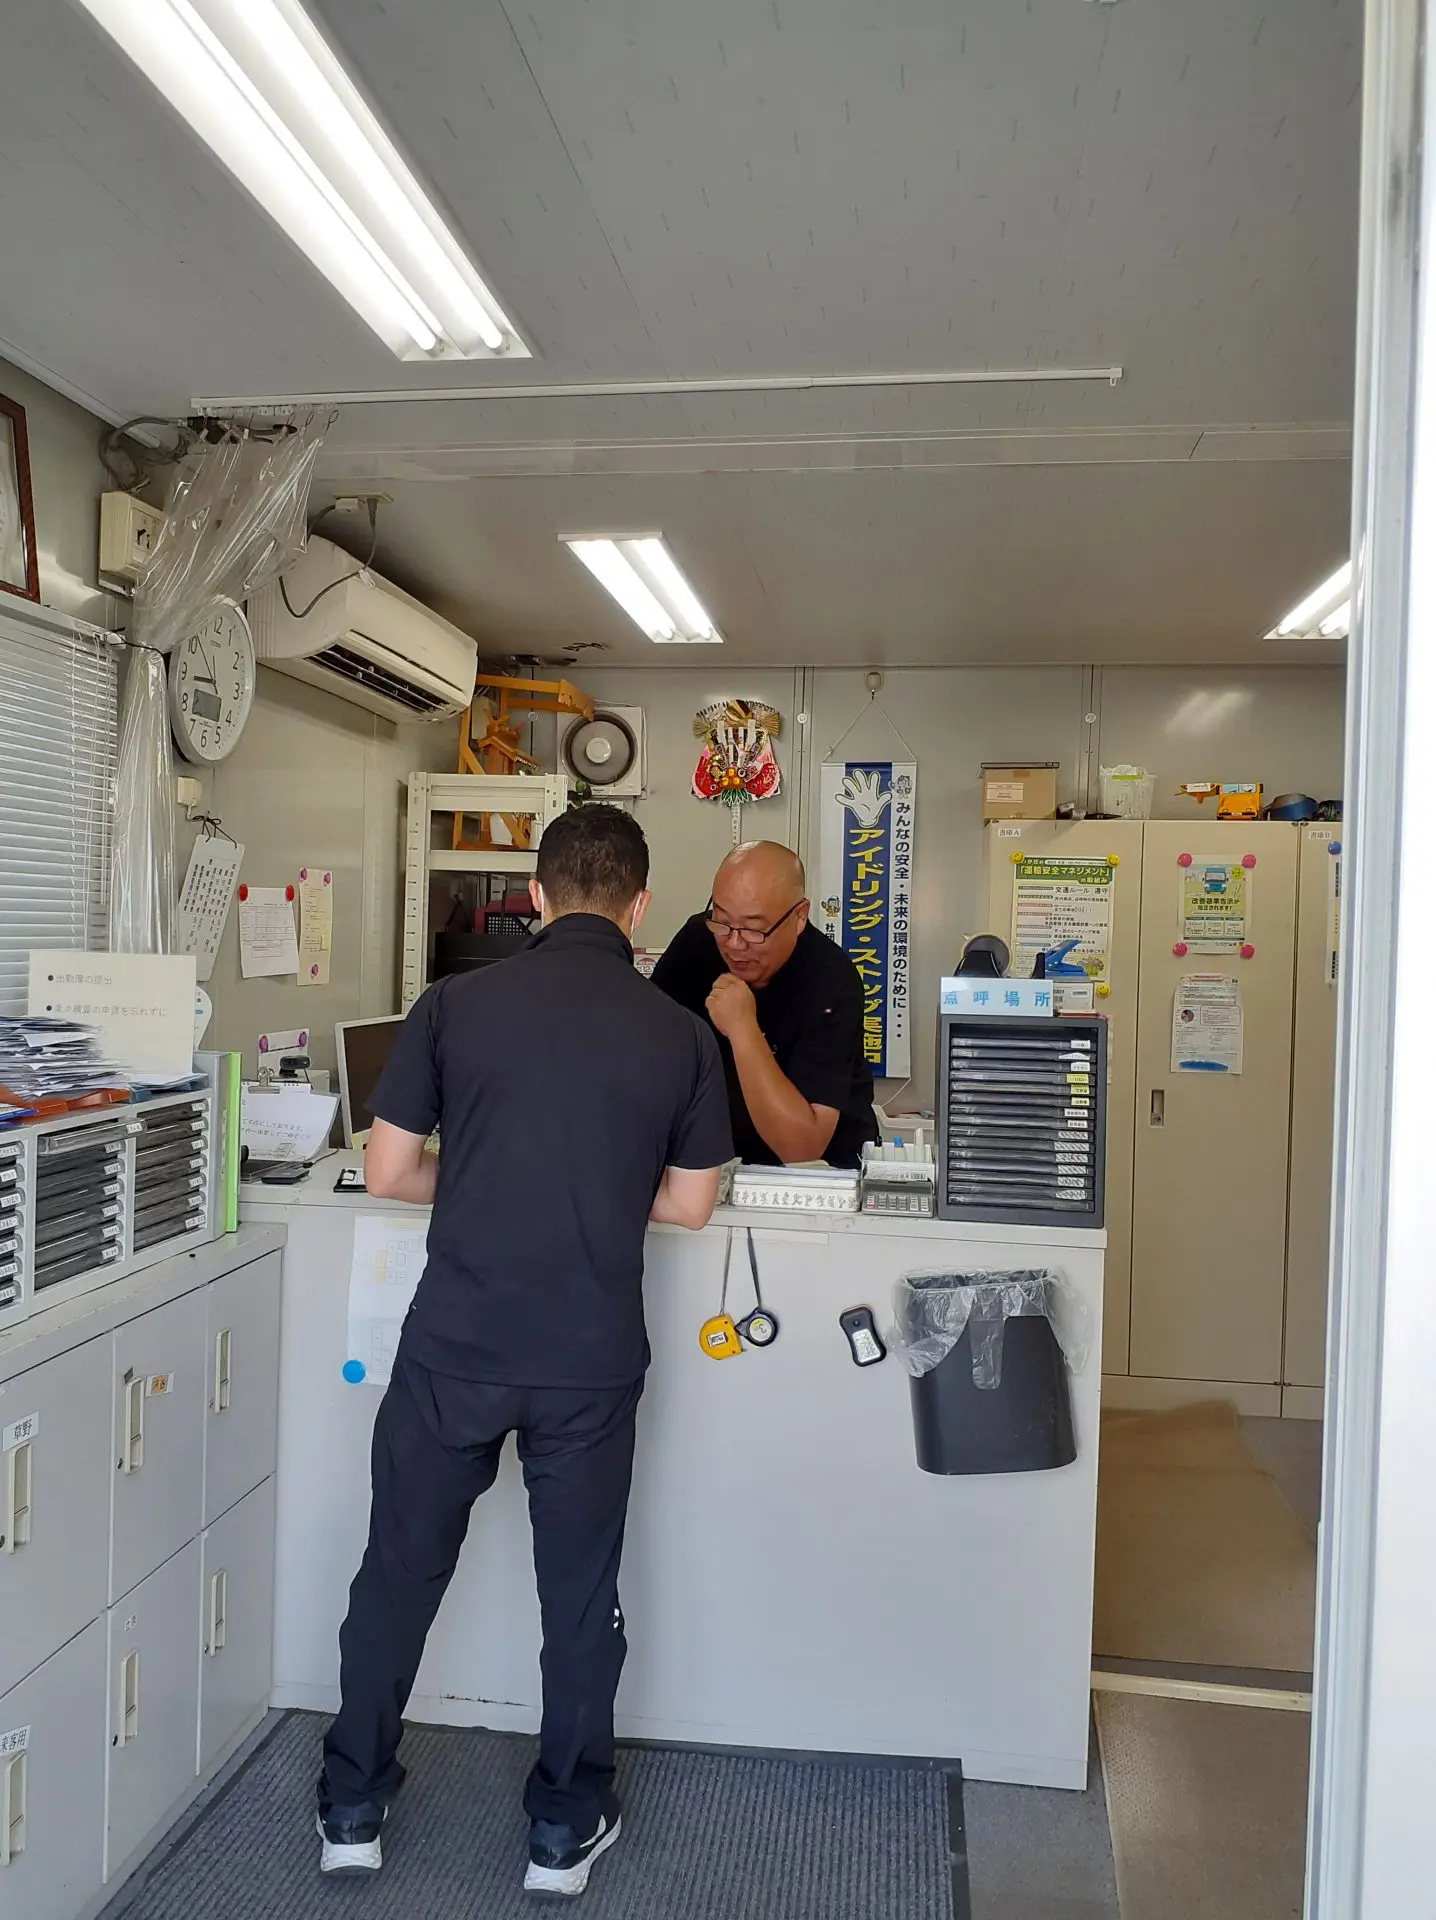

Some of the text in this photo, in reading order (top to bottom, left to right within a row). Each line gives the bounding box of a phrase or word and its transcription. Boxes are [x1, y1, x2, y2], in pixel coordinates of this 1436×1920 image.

[213, 617, 223, 635] 12
[188, 636, 197, 654] 10
[232, 651, 240, 671] 2
[181, 661, 188, 681] 9
[233, 682, 240, 701] 3
[181, 692, 189, 712] 8
[189, 718, 196, 737] 7
[225, 709, 232, 728] 4
[200, 729, 208, 748] 6
[214, 726, 222, 745] 5
[943, 990, 1051, 1008] 点呼場所
[14, 1418, 33, 1441] 草野
